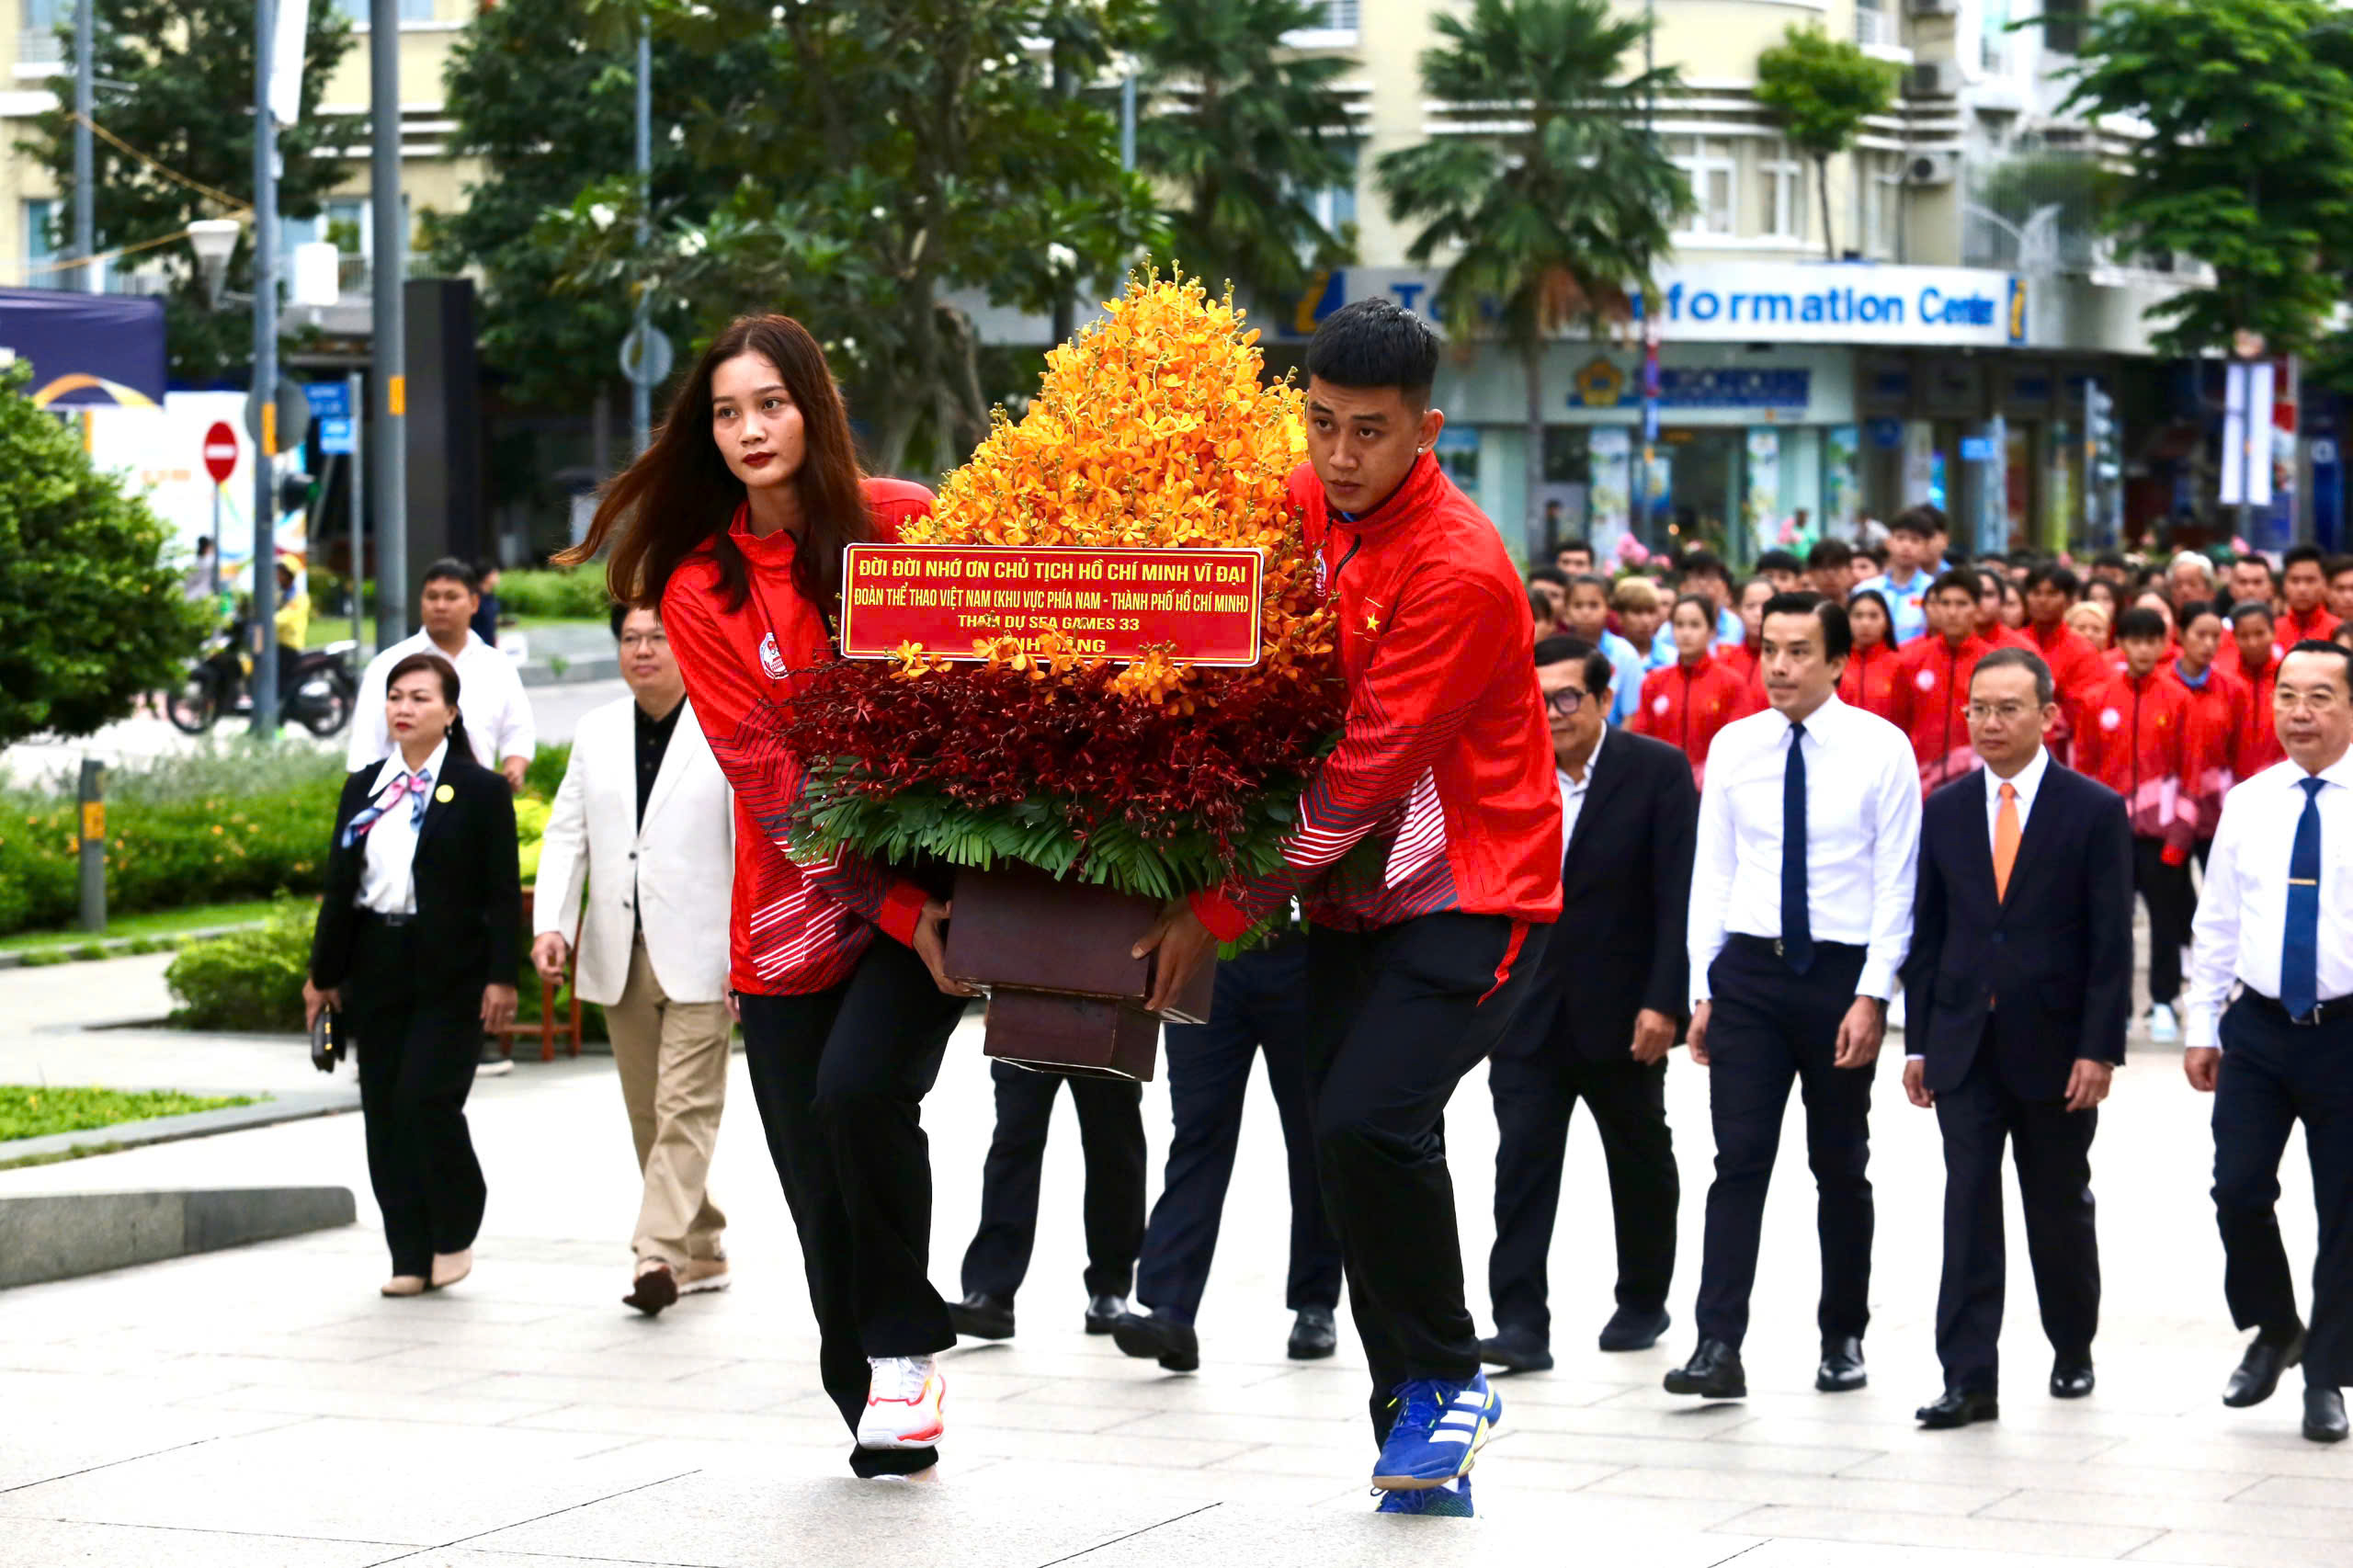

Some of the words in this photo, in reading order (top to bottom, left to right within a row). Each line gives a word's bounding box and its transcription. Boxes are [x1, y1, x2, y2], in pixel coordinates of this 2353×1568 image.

[858, 557, 887, 576] ĐỜI
[892, 558, 921, 577] ĐỜI
[926, 558, 962, 577] NHỚ
[966, 561, 990, 578] ƠN
[994, 558, 1029, 578] CHỦ
[1034, 562, 1074, 582] TỊCH
[1078, 559, 1104, 580] HỒ
[1108, 562, 1139, 581] CHÍ
[1142, 564, 1188, 582] MINH
[1194, 562, 1213, 582] VĨ
[1215, 565, 1246, 585] ĐẠI
[854, 585, 883, 606] ĐOÀN
[886, 582, 909, 606] THỂ
[909, 588, 938, 607] THAO
[939, 586, 963, 610] VIỆT
[966, 589, 990, 608] NAM
[994, 590, 1020, 608] (KHU
[1023, 590, 1045, 611] VỰC
[1047, 588, 1073, 609] PHÍA
[1074, 591, 1101, 609] NAM
[1111, 589, 1148, 611] THÀNH
[1151, 589, 1176, 611] PHỐ
[1176, 589, 1192, 611] HỒ
[1193, 591, 1213, 612] CHÍ
[1214, 595, 1249, 613] MINH)
[1005, 615, 1026, 631] DỰ
[1029, 617, 1058, 629] SEA
[1063, 617, 1116, 631] GAMES
[1119, 618, 1140, 631] 33
